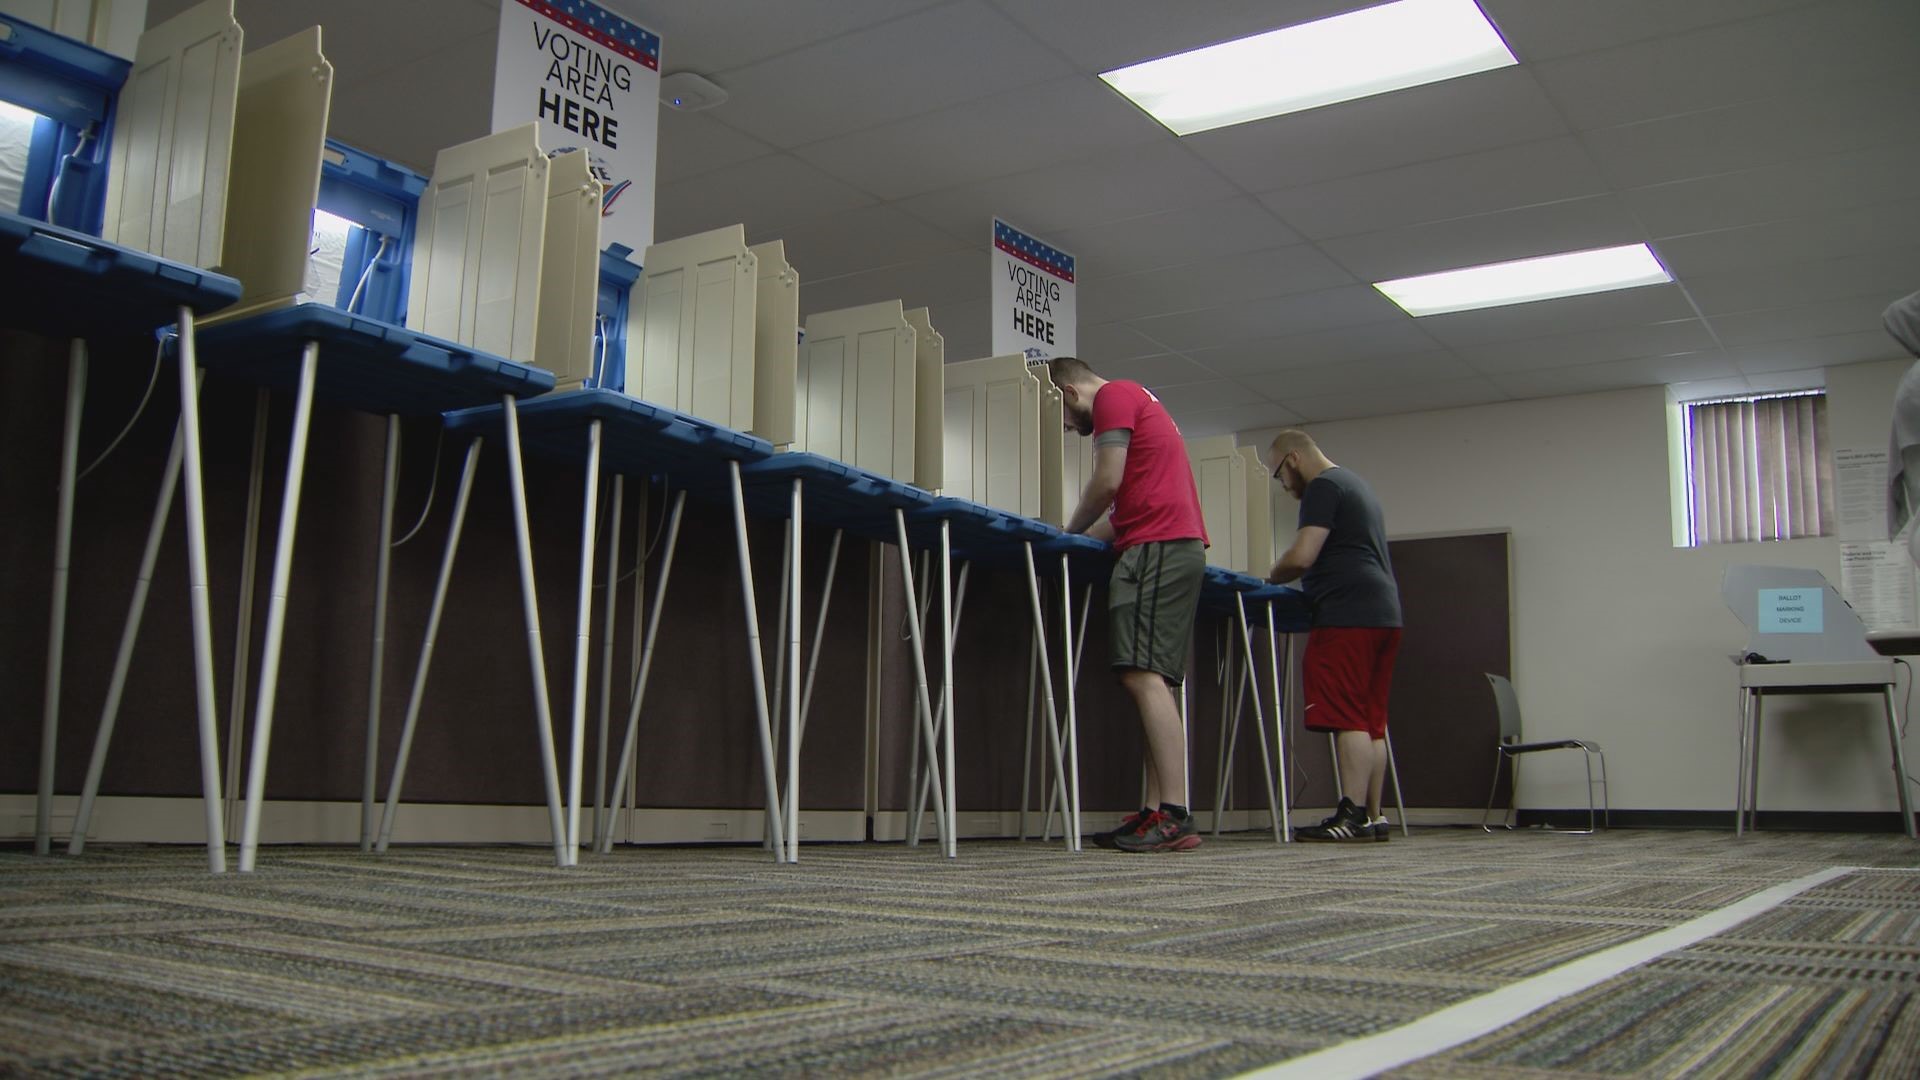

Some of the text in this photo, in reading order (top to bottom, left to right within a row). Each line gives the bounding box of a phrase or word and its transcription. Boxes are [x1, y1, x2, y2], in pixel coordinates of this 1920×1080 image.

[533, 21, 631, 92] VOTING
[546, 60, 614, 110] AREA
[539, 87, 618, 149] HERE
[1007, 261, 1060, 302] VOTING
[1016, 286, 1052, 317] AREA
[1013, 307, 1055, 345] HERE
